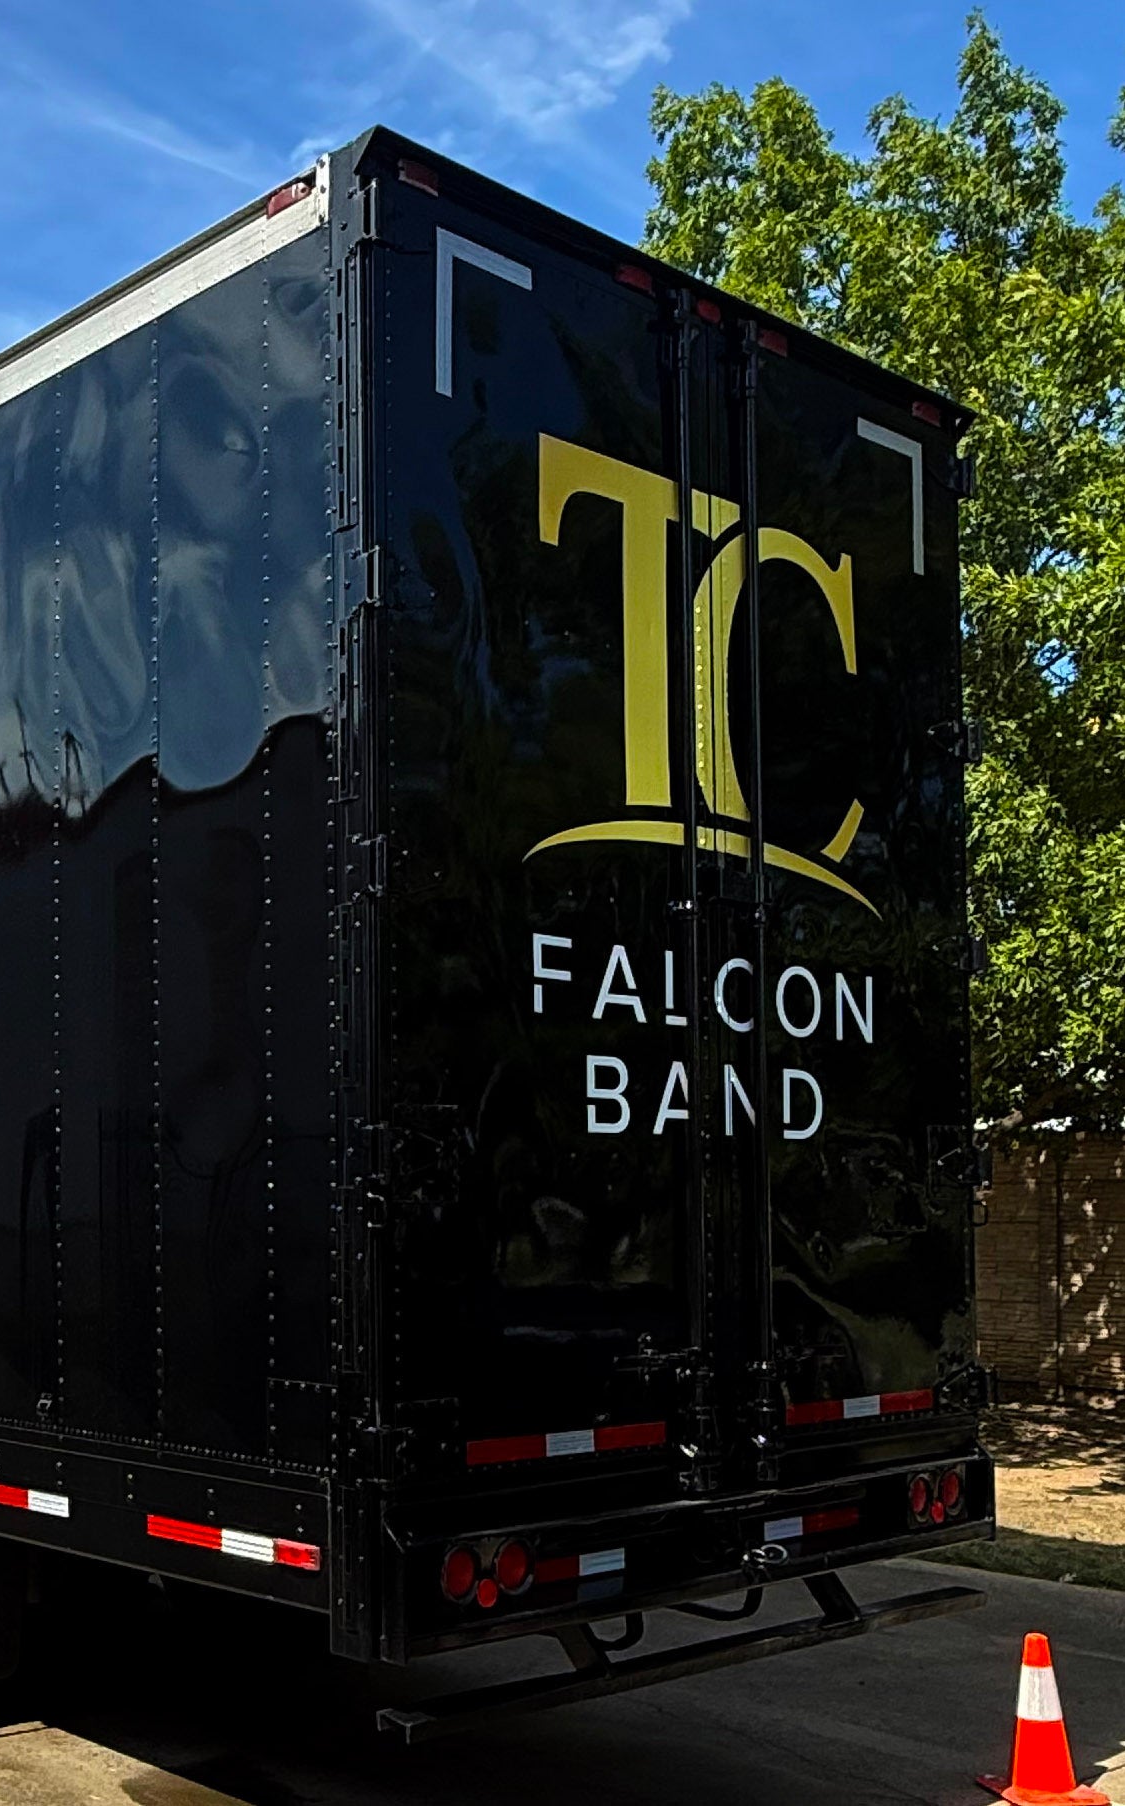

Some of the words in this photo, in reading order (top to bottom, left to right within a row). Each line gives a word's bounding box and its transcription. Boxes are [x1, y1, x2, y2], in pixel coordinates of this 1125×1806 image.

[538, 432, 865, 863] TC
[532, 932, 875, 1044] FALCON
[585, 1054, 824, 1140] BAND
